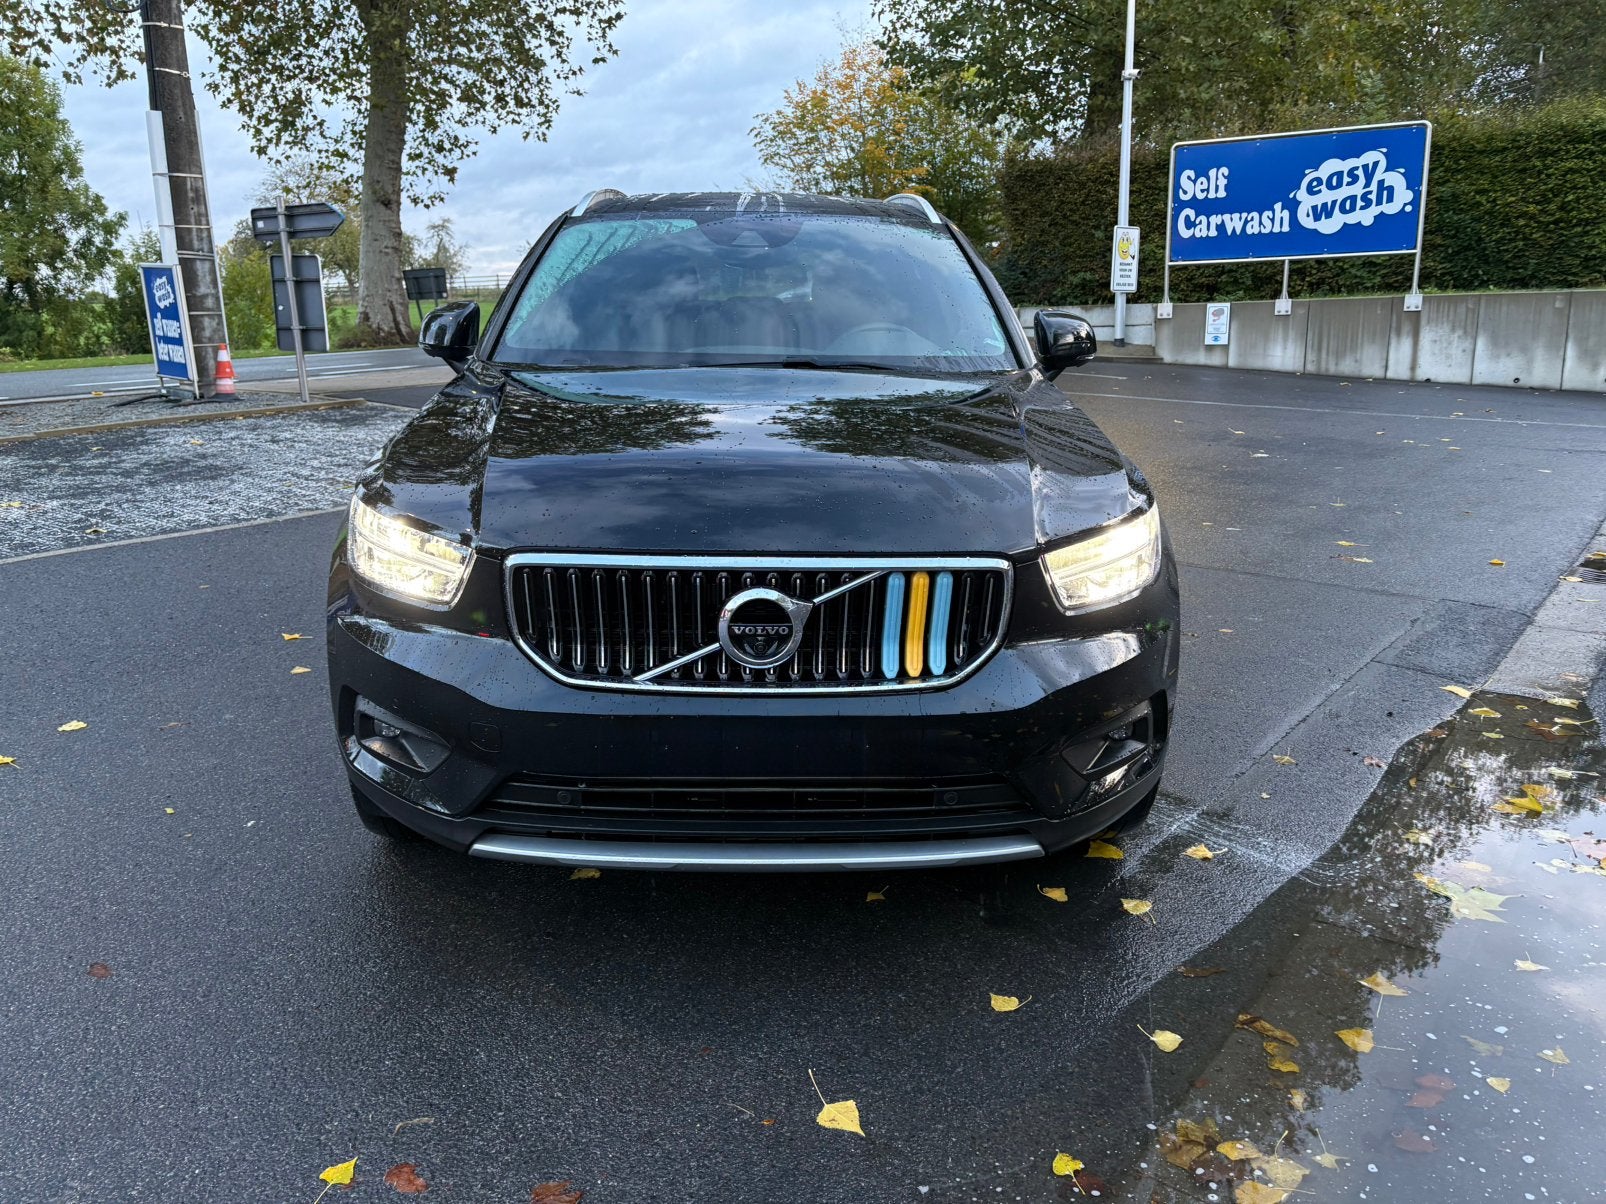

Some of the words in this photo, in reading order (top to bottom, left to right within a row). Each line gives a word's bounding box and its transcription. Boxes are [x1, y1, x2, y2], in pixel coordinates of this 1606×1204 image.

[1179, 166, 1229, 201] Self
[1306, 159, 1381, 196] easy
[1310, 178, 1395, 223] wash
[1177, 201, 1290, 239] Carwash
[155, 281, 167, 293] easy
[157, 288, 171, 303] wash
[731, 626, 789, 635] VOLVO
